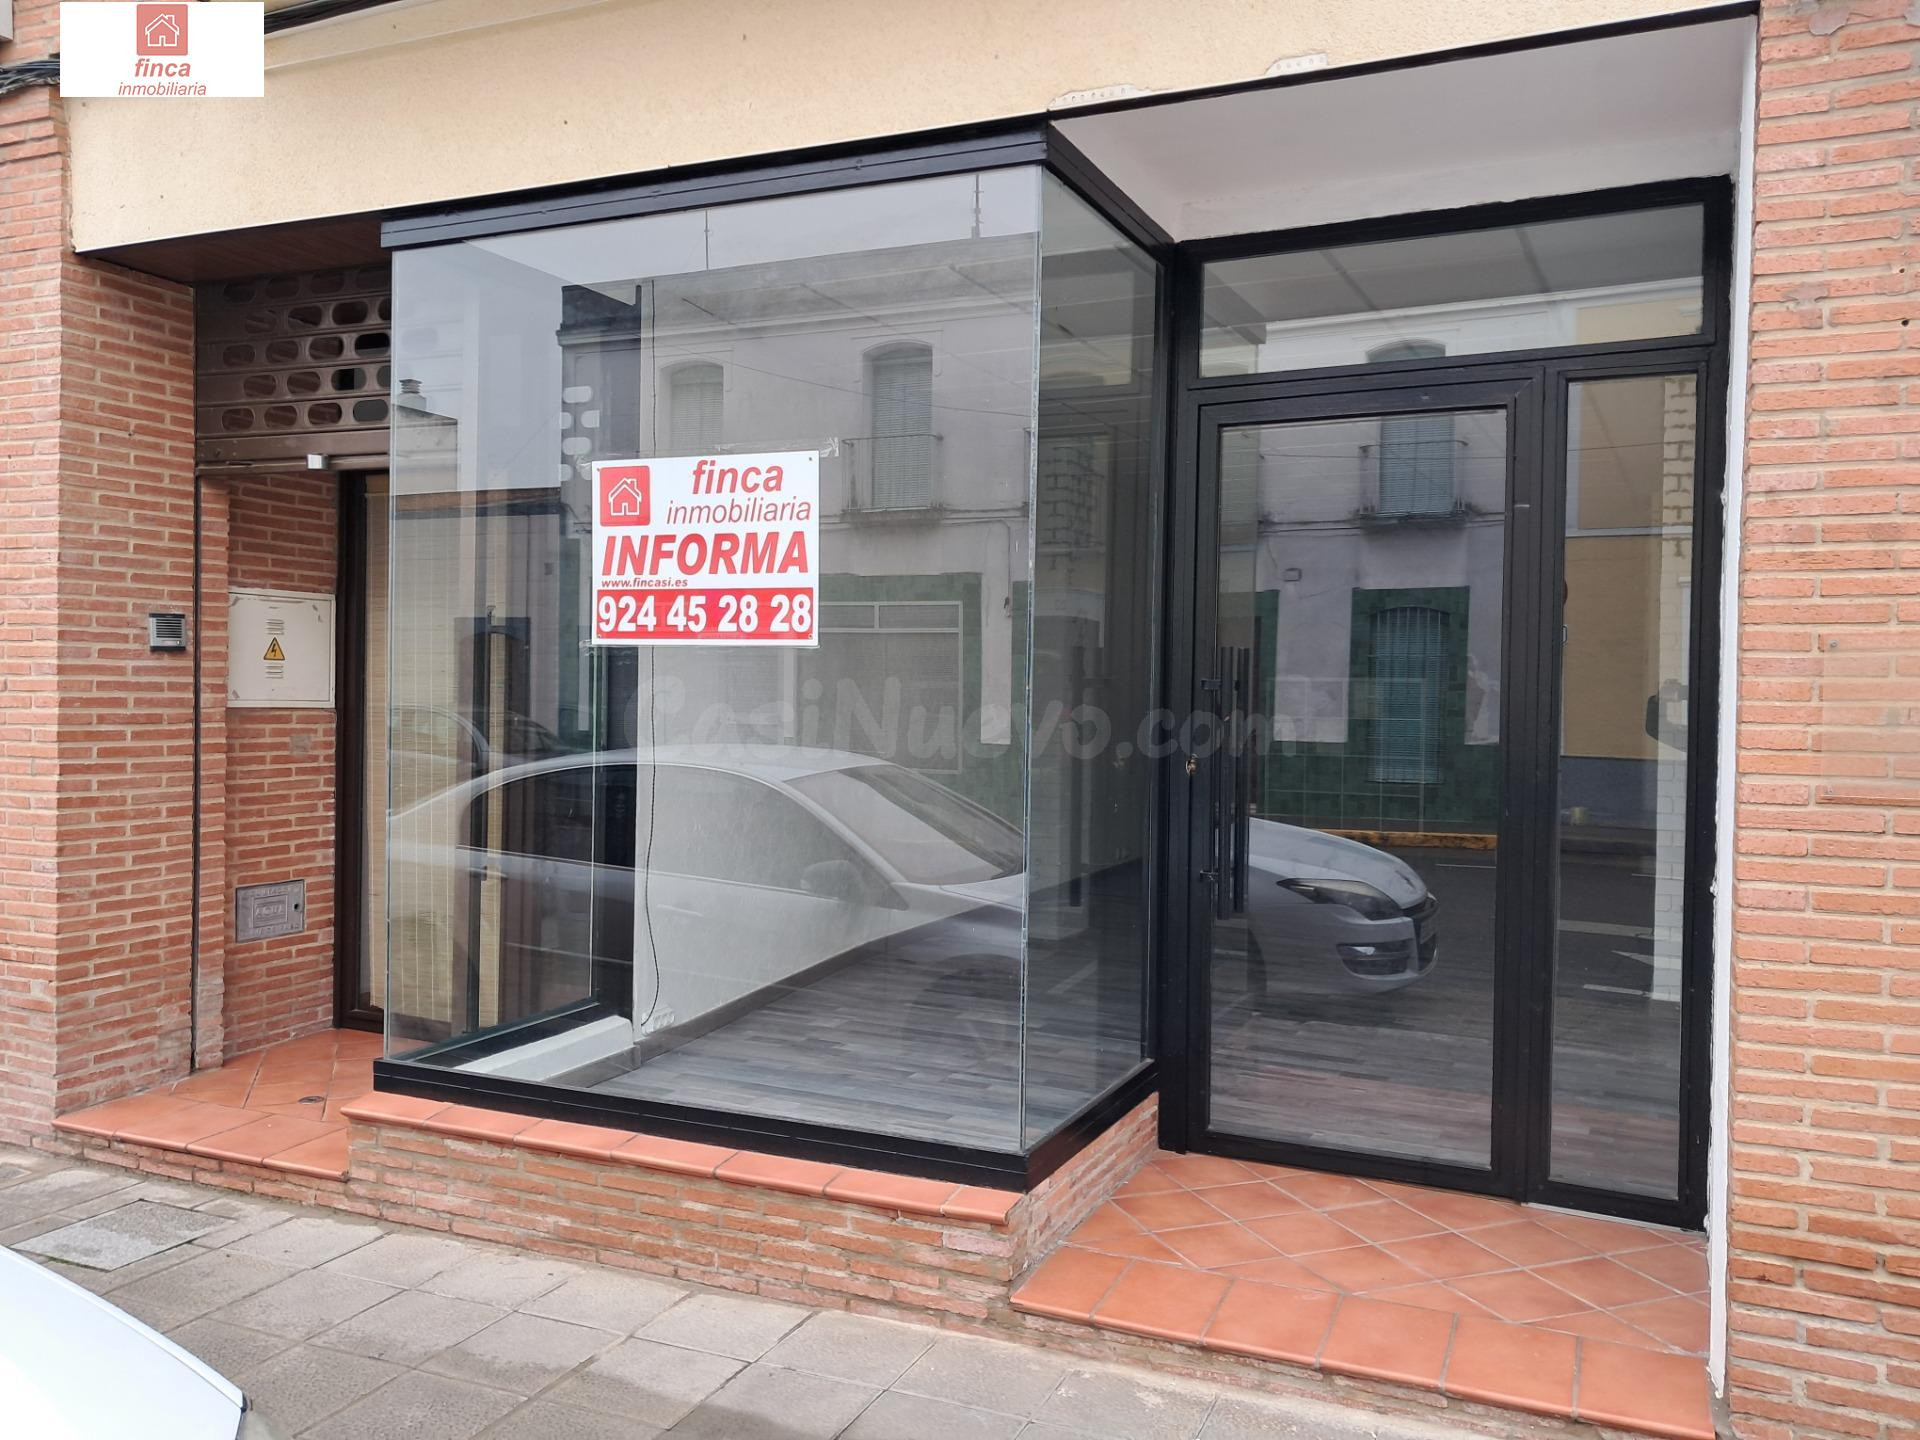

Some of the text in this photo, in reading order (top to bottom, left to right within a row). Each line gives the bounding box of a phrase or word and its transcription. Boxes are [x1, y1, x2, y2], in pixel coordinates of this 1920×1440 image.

[691, 459, 784, 495] finca
[666, 496, 812, 525] inmobiliaria
[601, 530, 809, 576] INFORMA
[601, 577, 688, 588] www.fincasi.es
[598, 594, 812, 633] 924 45 28 28
